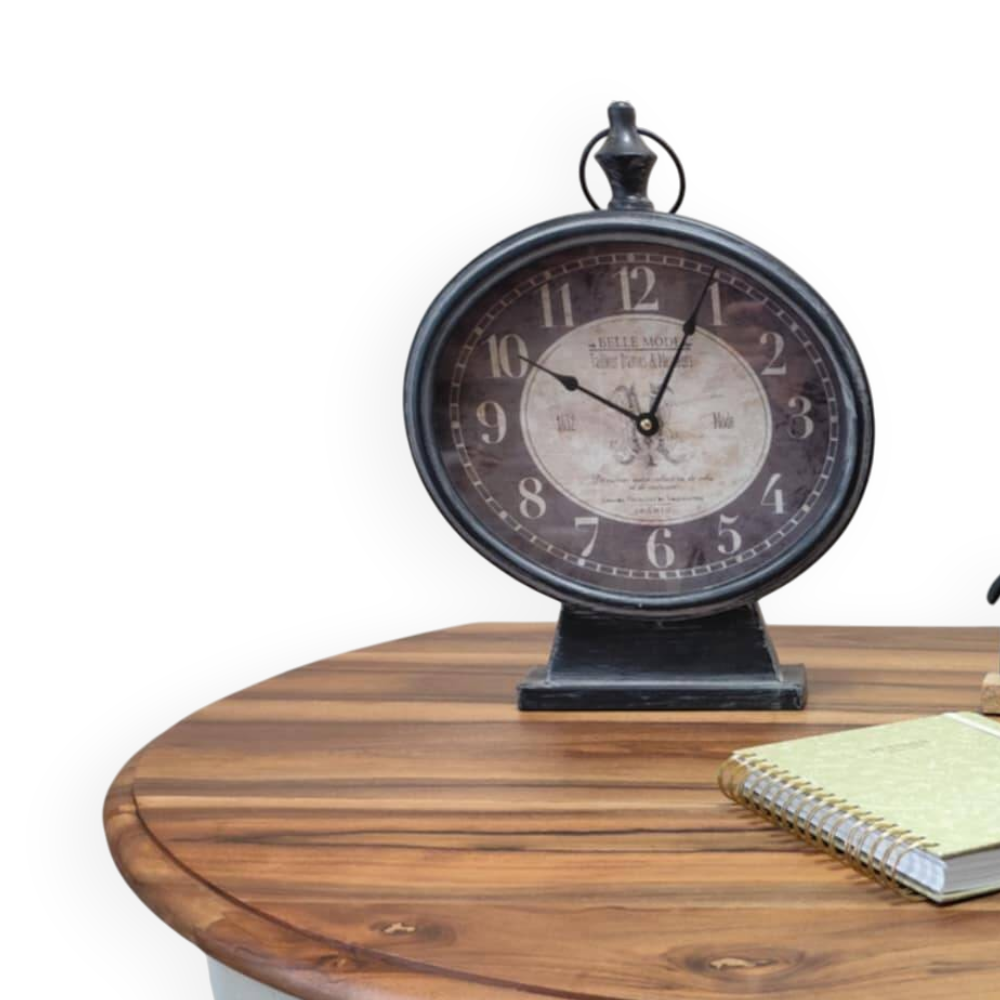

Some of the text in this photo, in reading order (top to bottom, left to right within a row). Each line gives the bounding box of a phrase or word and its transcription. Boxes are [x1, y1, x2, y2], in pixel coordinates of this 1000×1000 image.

[539, 282, 575, 328] 11
[612, 265, 660, 311] 12
[707, 281, 726, 326] 1
[486, 333, 529, 378] 10
[759, 331, 788, 376] 2
[475, 401, 508, 445] 9
[787, 395, 814, 440] 3
[517, 476, 547, 520] 8
[760, 472, 785, 515] 4
[573, 516, 599, 558] 7
[645, 527, 676, 569] 6
[716, 513, 742, 555] 5
